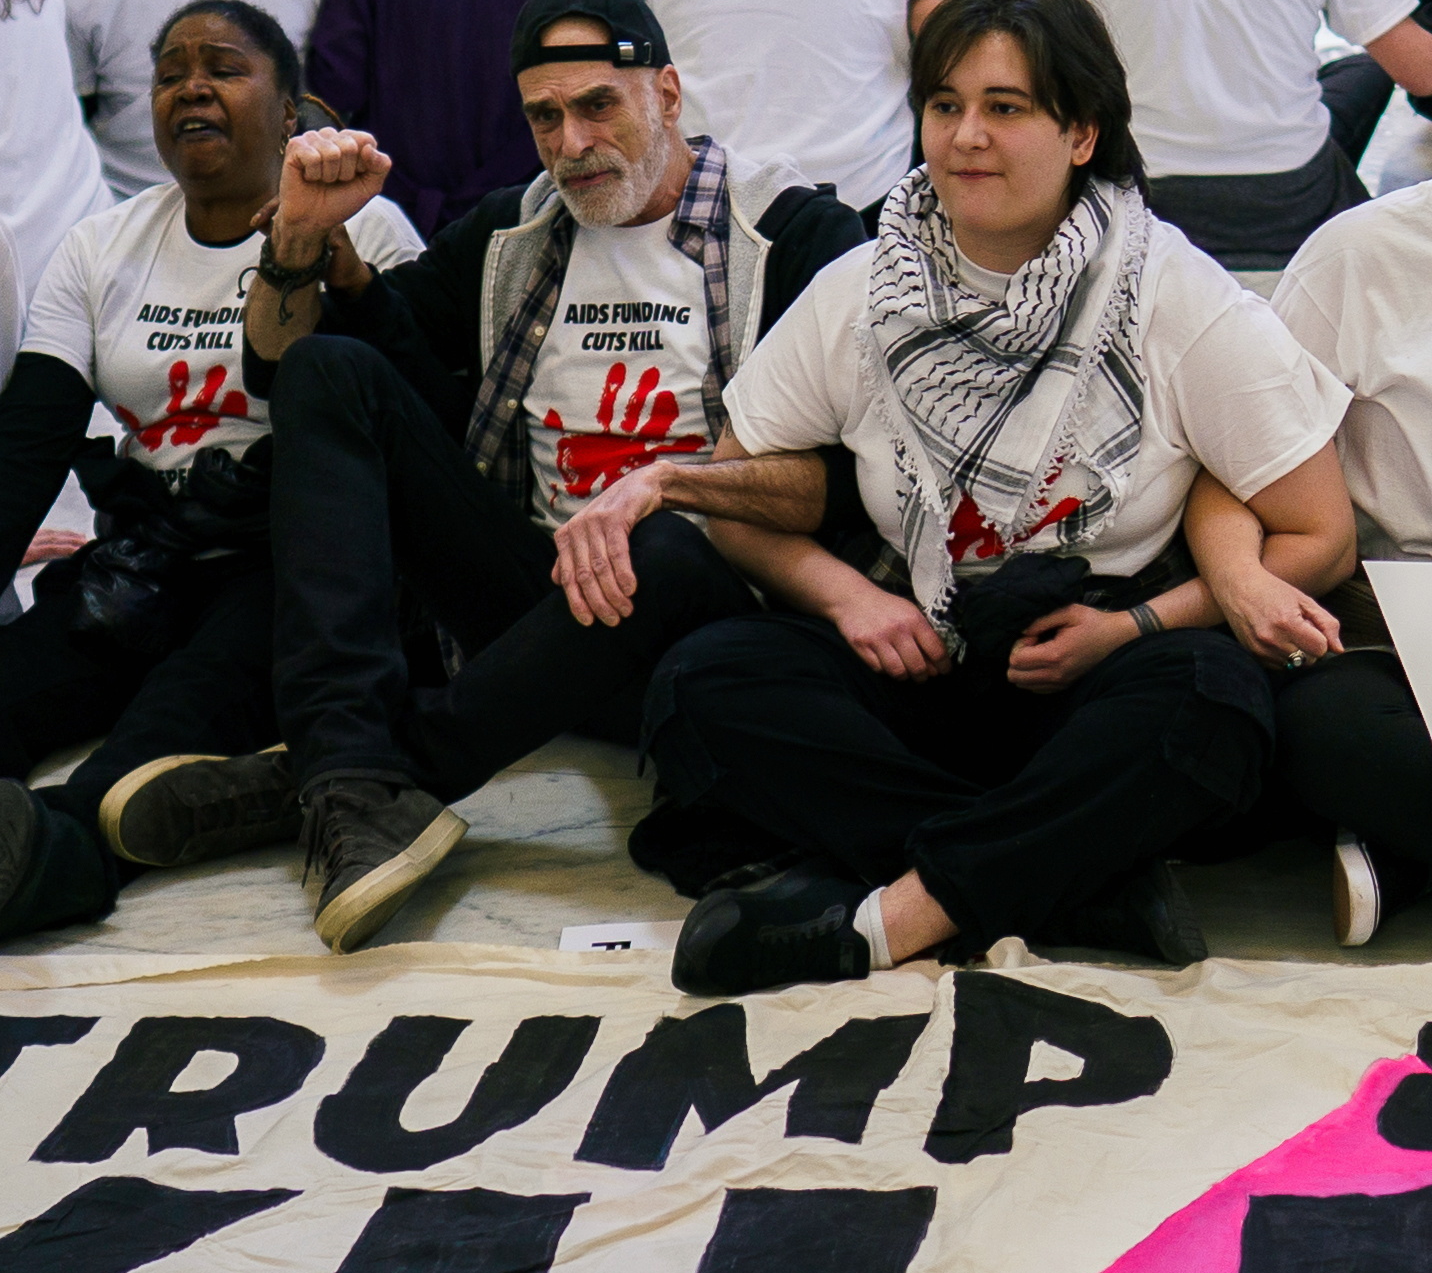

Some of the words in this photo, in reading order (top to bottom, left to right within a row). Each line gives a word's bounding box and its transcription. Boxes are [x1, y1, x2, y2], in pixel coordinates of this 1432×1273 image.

[137, 303, 183, 326] AIDS
[182, 307, 245, 329] FUNDI
[563, 303, 608, 325] AIDS
[610, 302, 692, 326] FUNDING
[147, 331, 193, 352] CUTS
[194, 330, 234, 351] KILL
[581, 330, 628, 352] CUTS
[628, 330, 665, 351] KILL
